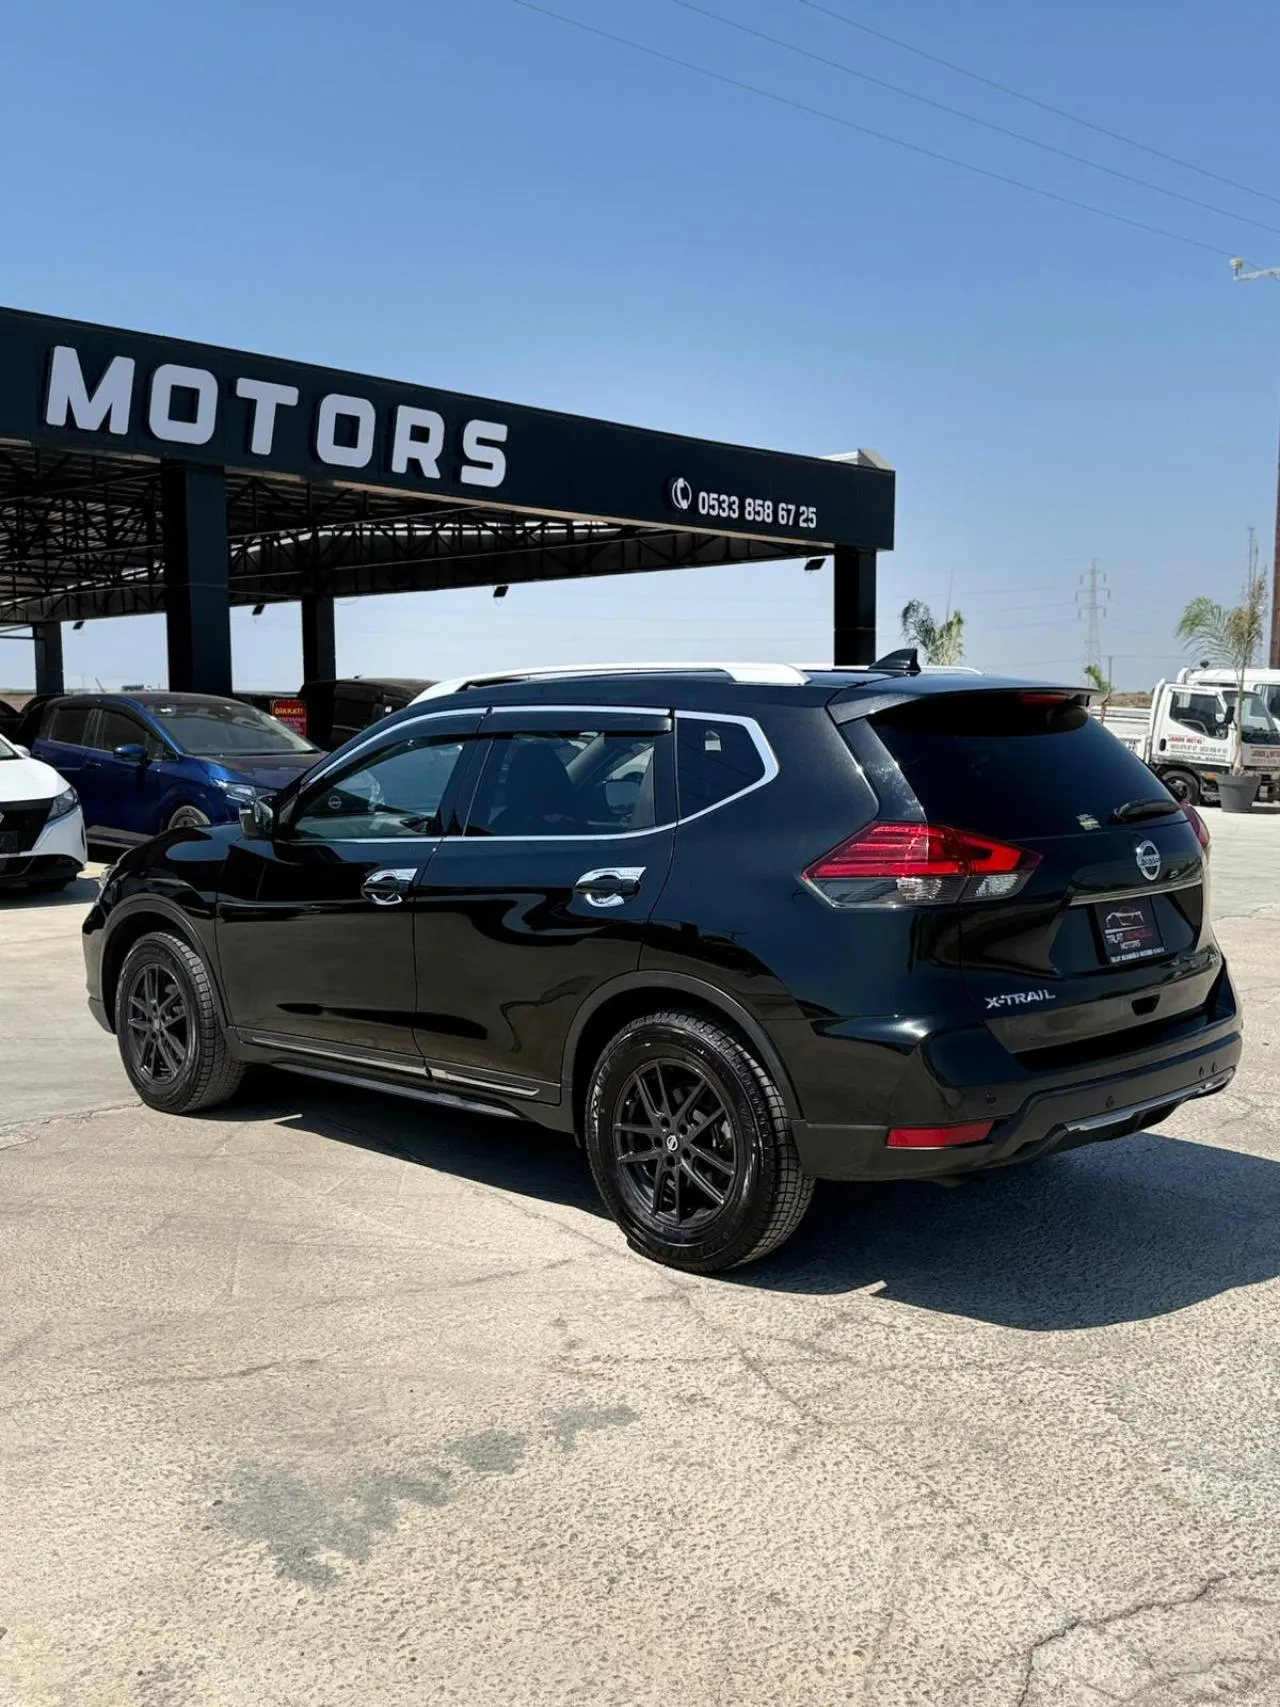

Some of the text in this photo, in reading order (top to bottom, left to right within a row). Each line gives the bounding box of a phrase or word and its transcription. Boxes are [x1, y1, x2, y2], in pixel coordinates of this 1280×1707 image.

[46, 345, 508, 488] MOTORS
[698, 491, 817, 528] 0533 858 67 25
[984, 989, 1057, 1009] X-TRAIL
